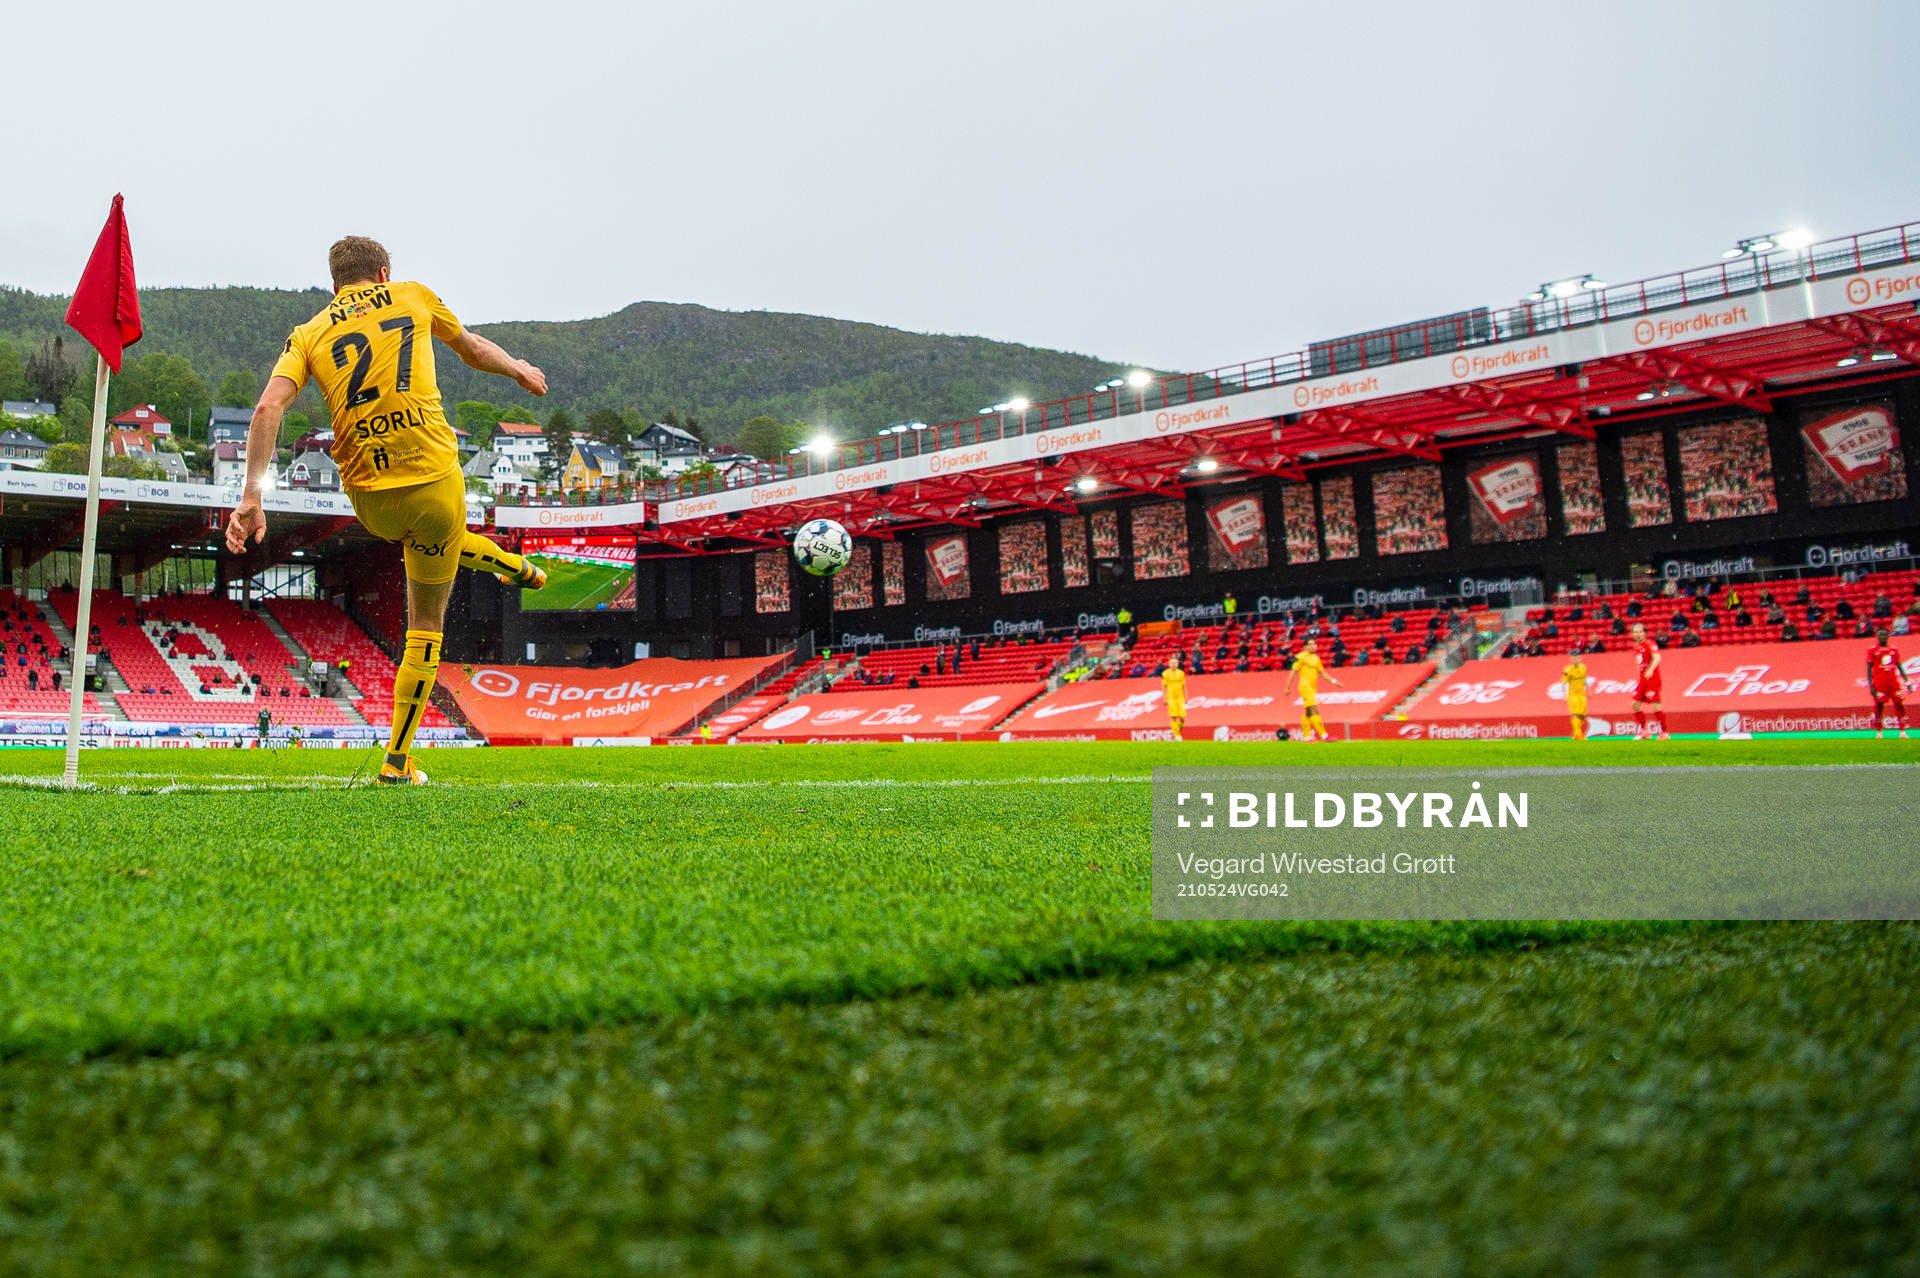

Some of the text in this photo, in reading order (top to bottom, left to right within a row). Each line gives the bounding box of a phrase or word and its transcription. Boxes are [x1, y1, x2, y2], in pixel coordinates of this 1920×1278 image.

[1658, 306, 1749, 341] Fjordkraft
[331, 315, 415, 410] 27
[1472, 344, 1549, 374] Fjordkraft
[1312, 377, 1379, 404] Fjordkraft
[355, 407, 426, 439] SØRLI
[1171, 404, 1230, 430] Fjordkraft
[1050, 428, 1102, 451] Fjordkraft
[942, 450, 988, 471] Fjordkraft
[67, 482, 87, 491] BOB
[847, 468, 888, 488] Fjordkraft
[151, 488, 169, 497] BOB
[761, 486, 798, 504] Fjordkraft
[317, 501, 334, 509] BOB
[684, 500, 717, 515] Fjordkraft
[553, 511, 604, 524] Fjordkraft
[812, 541, 842, 559] SELECT
[1829, 541, 1911, 566] Fjordkraft
[1684, 556, 1755, 579] Fjordkraft
[1369, 586, 1427, 606] Fjordkraft
[1477, 577, 1537, 597] Fjordkraft
[1177, 603, 1224, 619] Fjordkraft
[925, 627, 960, 641] Fjordkraft
[1004, 619, 1044, 635] Fjordkraft
[526, 673, 730, 706] Fjordkraft
[1739, 679, 1811, 696] BOB
[525, 700, 651, 721] Gjør en forskjell
[1428, 721, 1538, 739] FrendeForsikring
